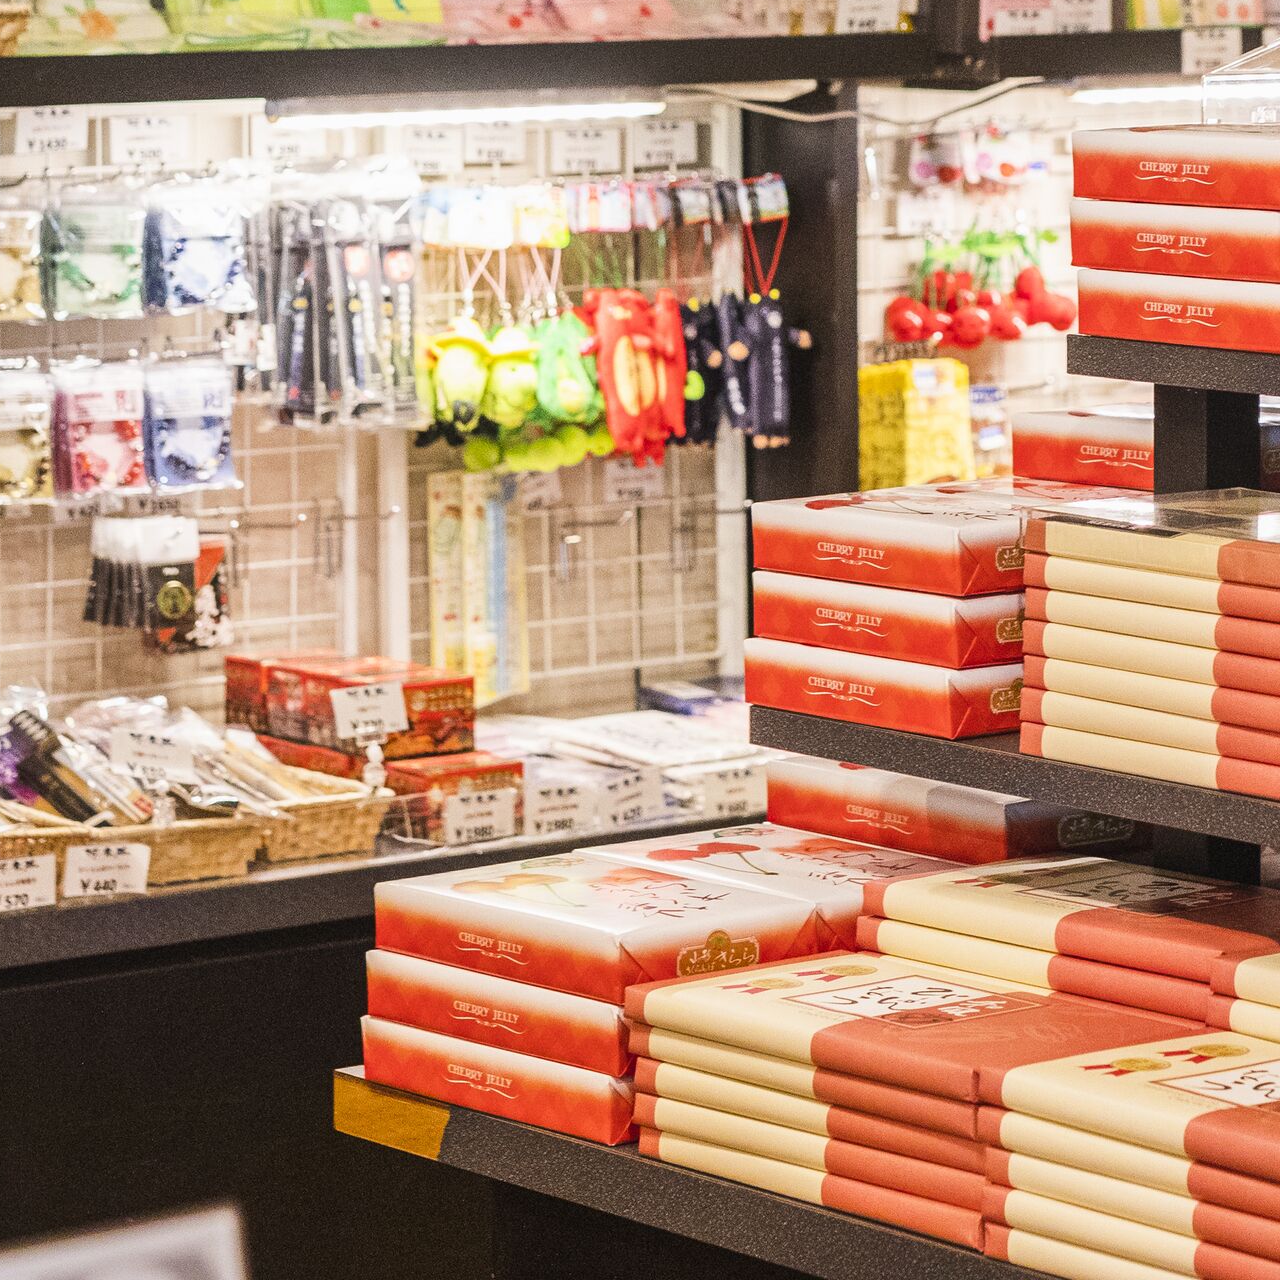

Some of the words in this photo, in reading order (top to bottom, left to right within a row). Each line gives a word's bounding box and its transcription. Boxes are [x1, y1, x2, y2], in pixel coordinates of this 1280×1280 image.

[1139, 161, 1178, 174] CHERRY
[1182, 164, 1210, 175] JELLY
[1136, 232, 1175, 246] CHERRY
[1179, 236, 1207, 248] JELLY
[1143, 301, 1183, 315] CHERRY
[1186, 305, 1215, 318] JELLY
[1080, 444, 1118, 459] CHERRY
[1123, 448, 1151, 461] JELLY
[817, 541, 854, 557] CHERRY
[857, 547, 885, 560] JELLY
[816, 607, 852, 622] CHERRY
[855, 613, 882, 627] JELLY
[807, 676, 845, 691] CHERRY
[848, 683, 876, 697] JELLY
[846, 804, 882, 820] CHERRY
[883, 811, 910, 825] JELLY
[458, 931, 494, 948] CHERRY
[497, 939, 524, 954] JELLY
[453, 1000, 489, 1017] CHERRY
[492, 1008, 520, 1024] JELLY
[447, 1063, 483, 1081] CHERRY
[486, 1073, 513, 1089] JELLY
